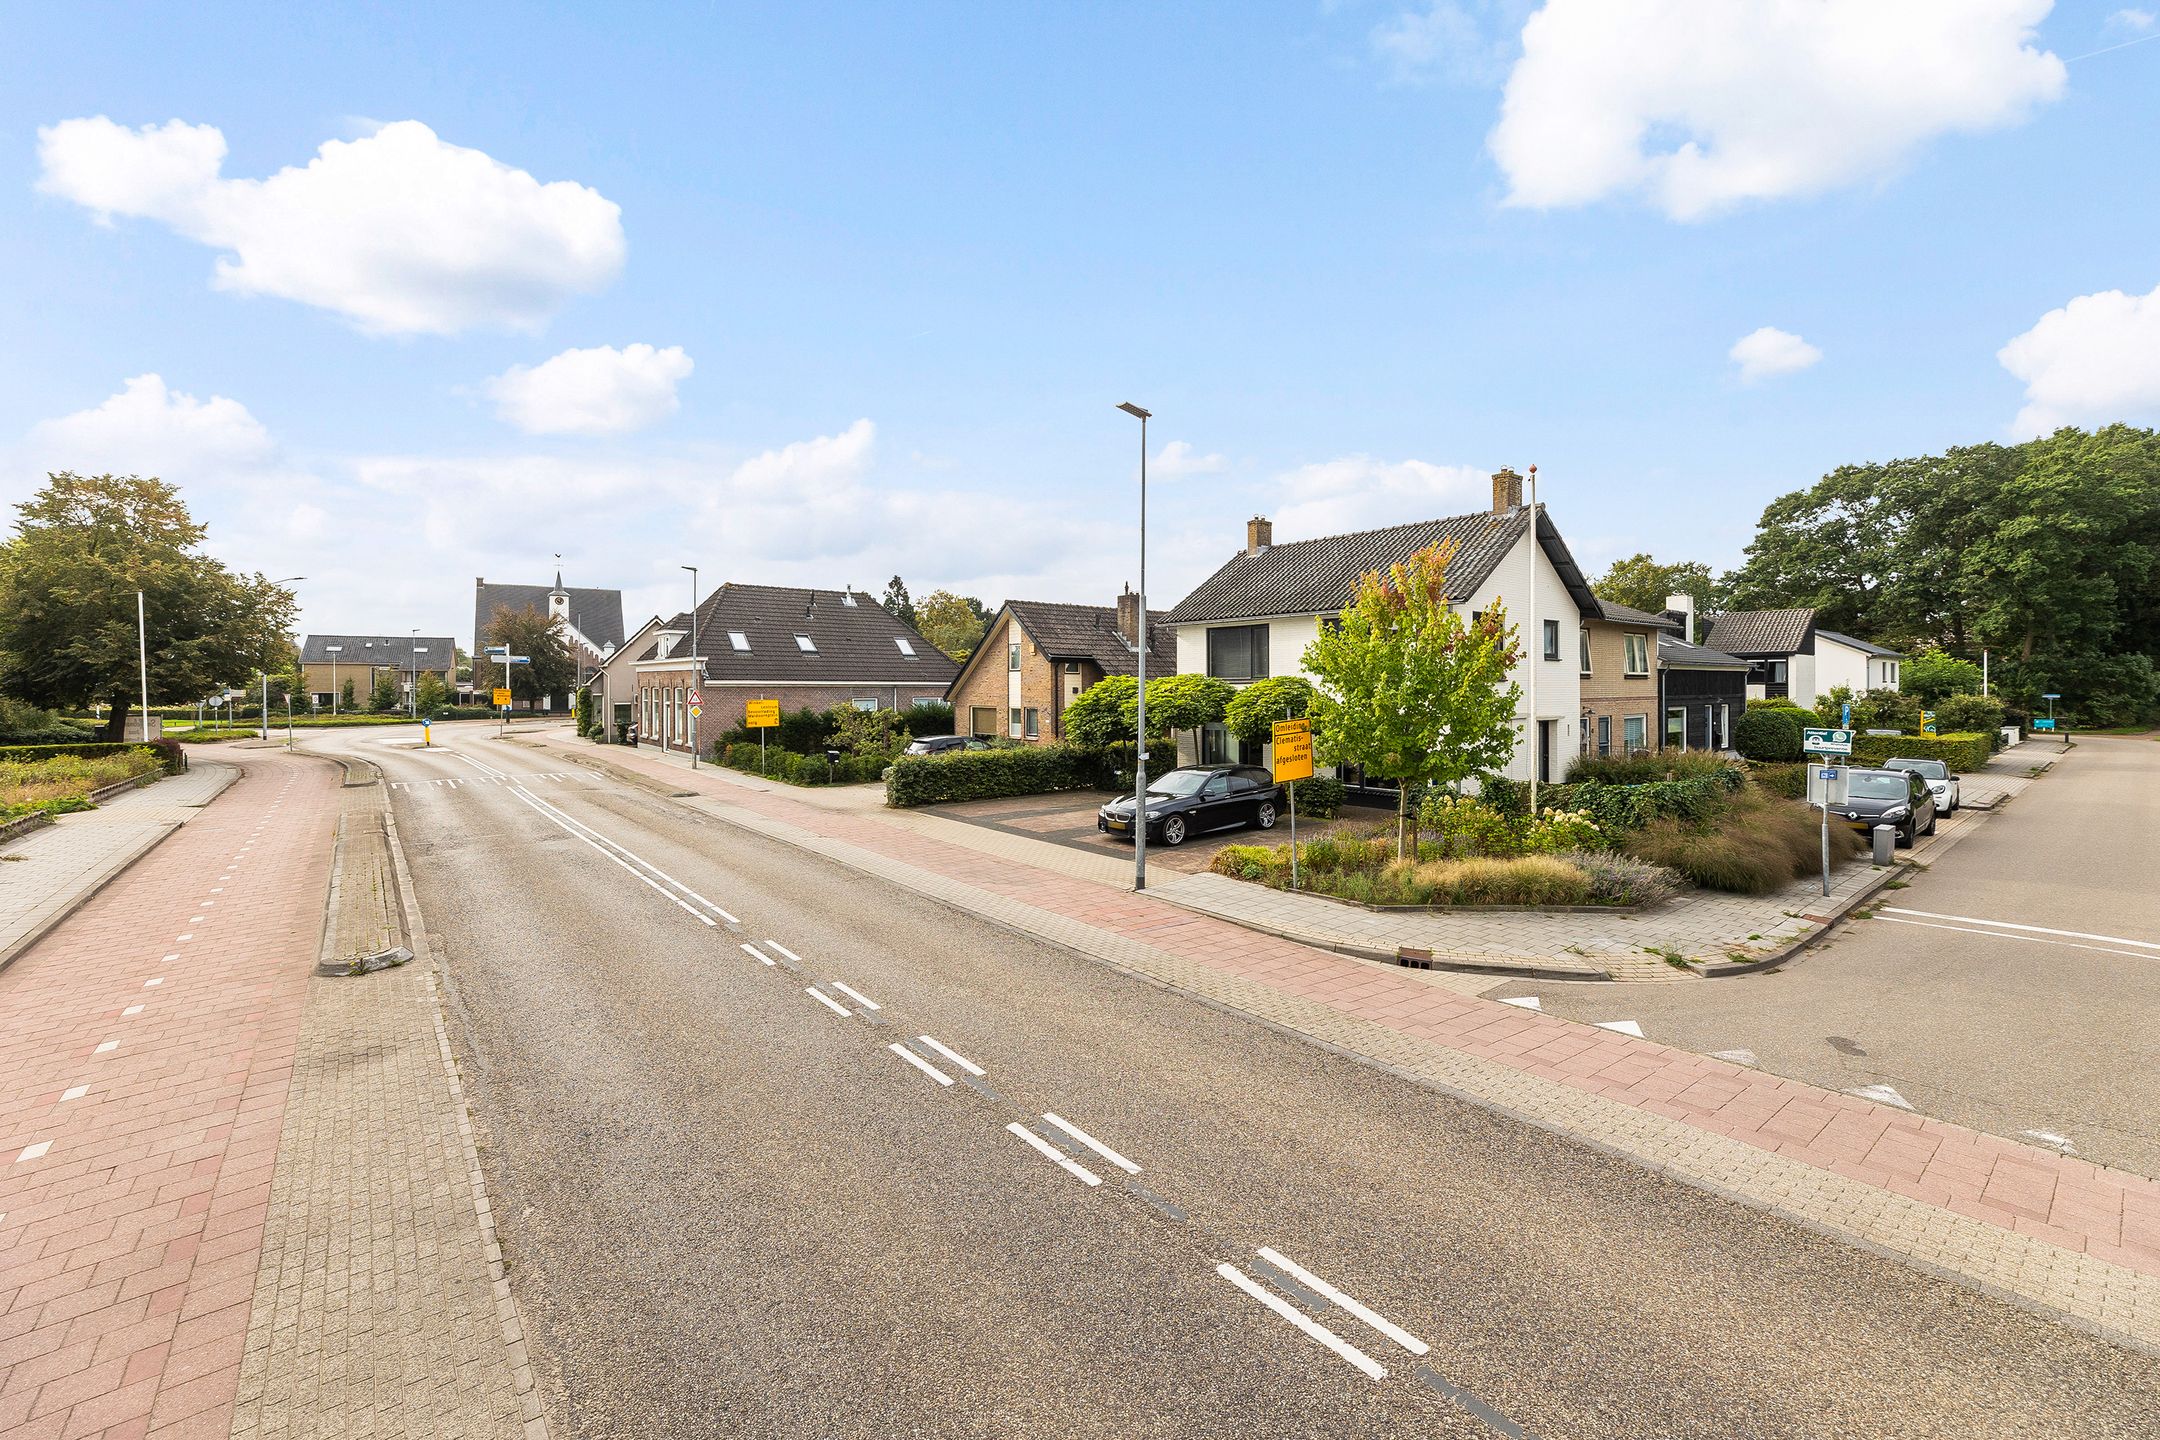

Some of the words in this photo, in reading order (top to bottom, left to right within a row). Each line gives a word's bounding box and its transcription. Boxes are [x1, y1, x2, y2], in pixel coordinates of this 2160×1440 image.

[1276, 734, 1304, 745] Clematis-
[1293, 743, 1311, 752] straat
[1276, 754, 1307, 765] afgesloten
